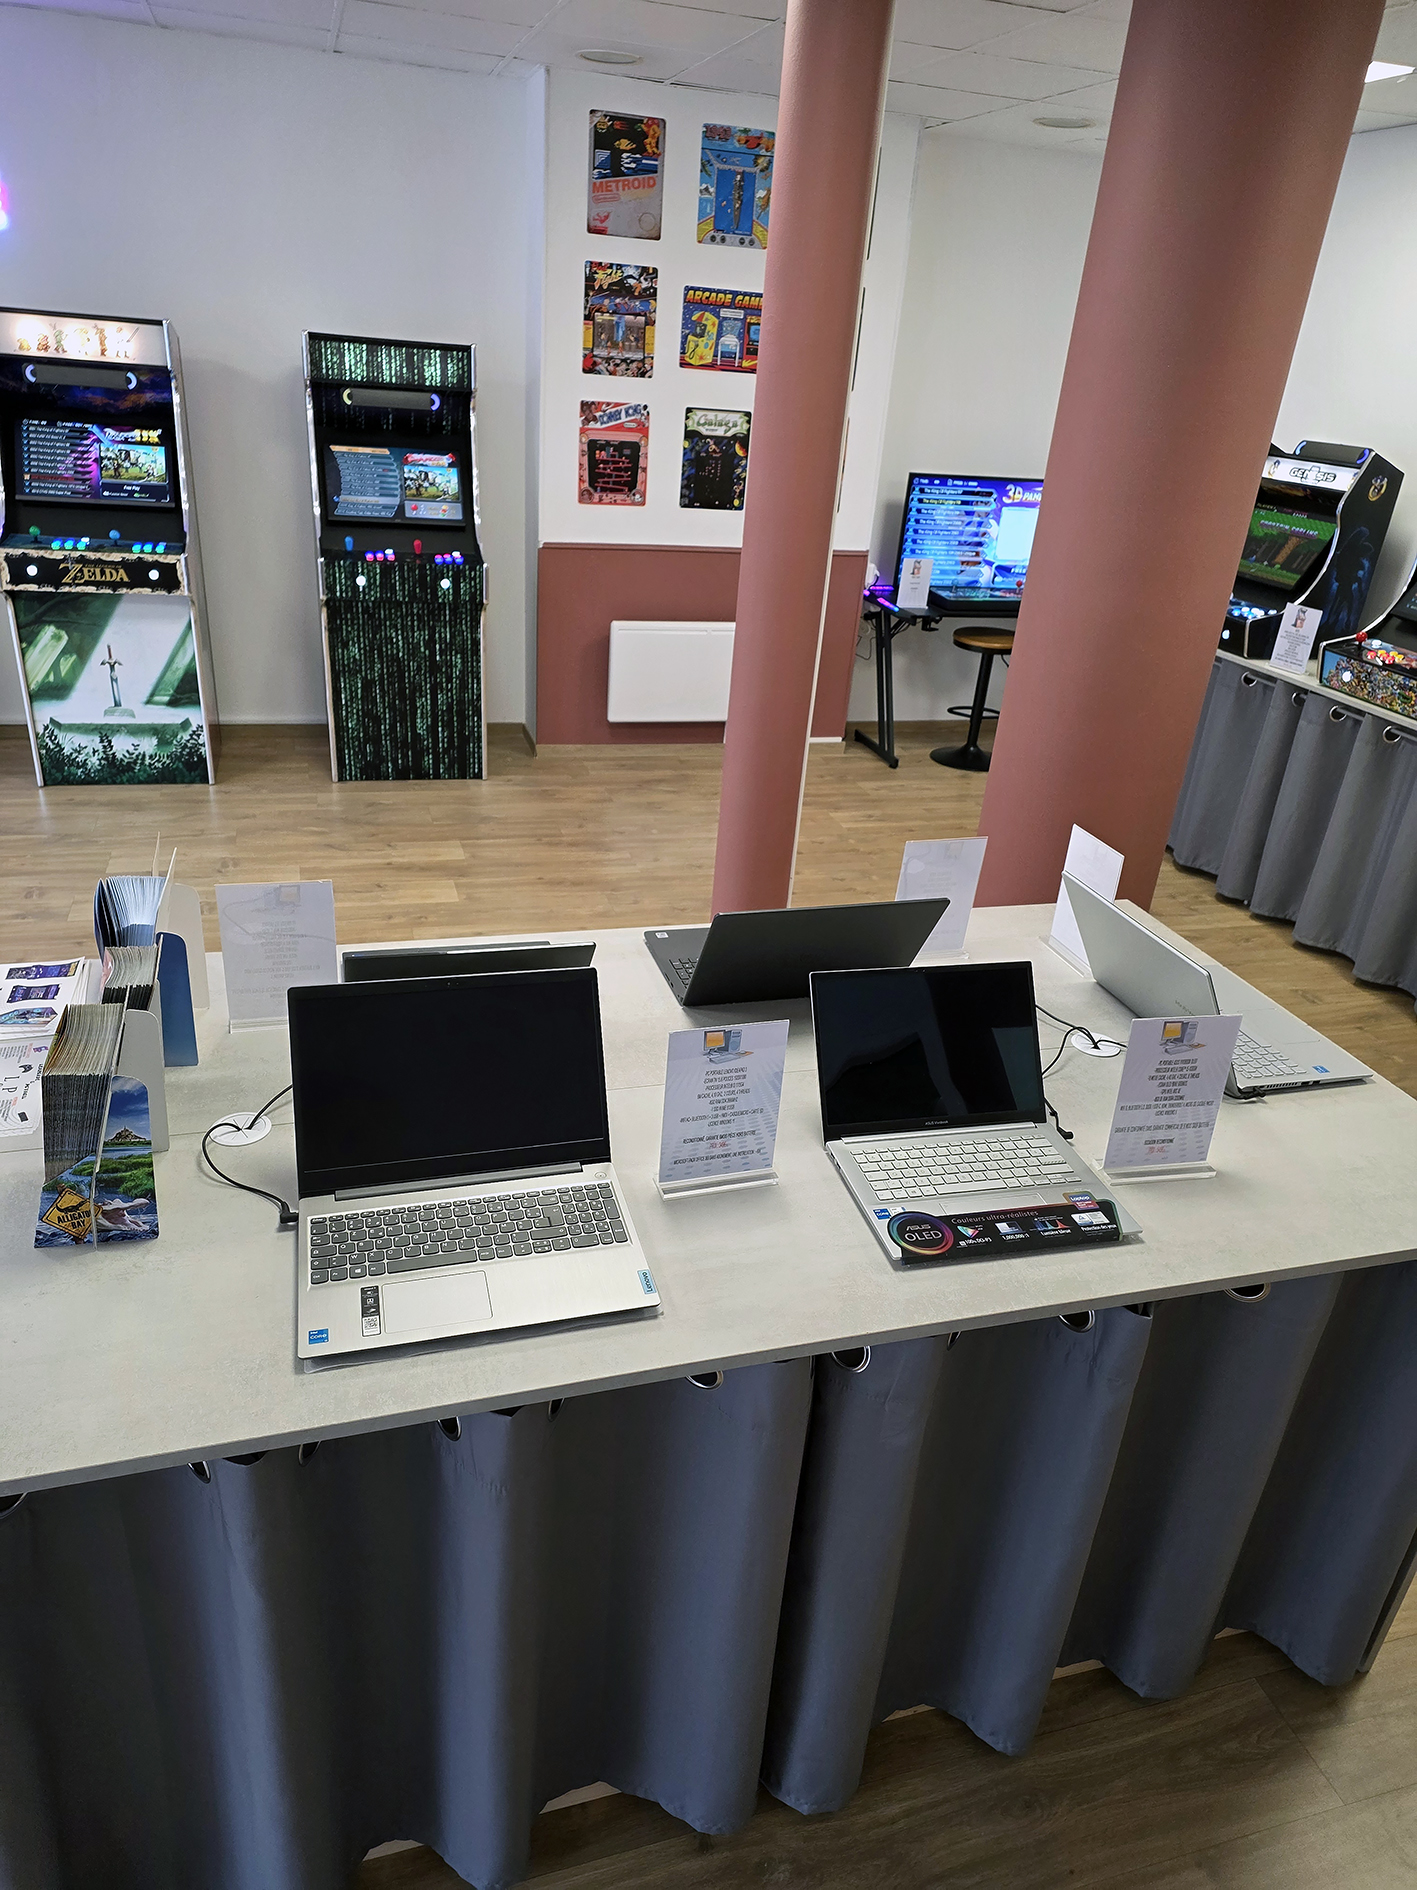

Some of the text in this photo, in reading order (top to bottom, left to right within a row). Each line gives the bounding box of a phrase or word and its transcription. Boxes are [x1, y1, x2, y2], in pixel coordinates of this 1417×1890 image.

[592, 178, 657, 194] METROID
[594, 269, 624, 290] Fight
[686, 290, 733, 306] ARCADE
[598, 403, 642, 426] DONKEY KONG
[696, 413, 738, 435] Galaga
[1002, 484, 1023, 503] 3D
[58, 563, 131, 584] ZELDA
[56, 1209, 92, 1224] ALLIGATO
[951, 1209, 1039, 1224] Couleurs ultra-réalistes
[71, 1220, 86, 1230] BAY
[906, 1223, 931, 1231] ASUS
[904, 1230, 943, 1242] OLED
[642, 1271, 653, 1293] Lenovo
